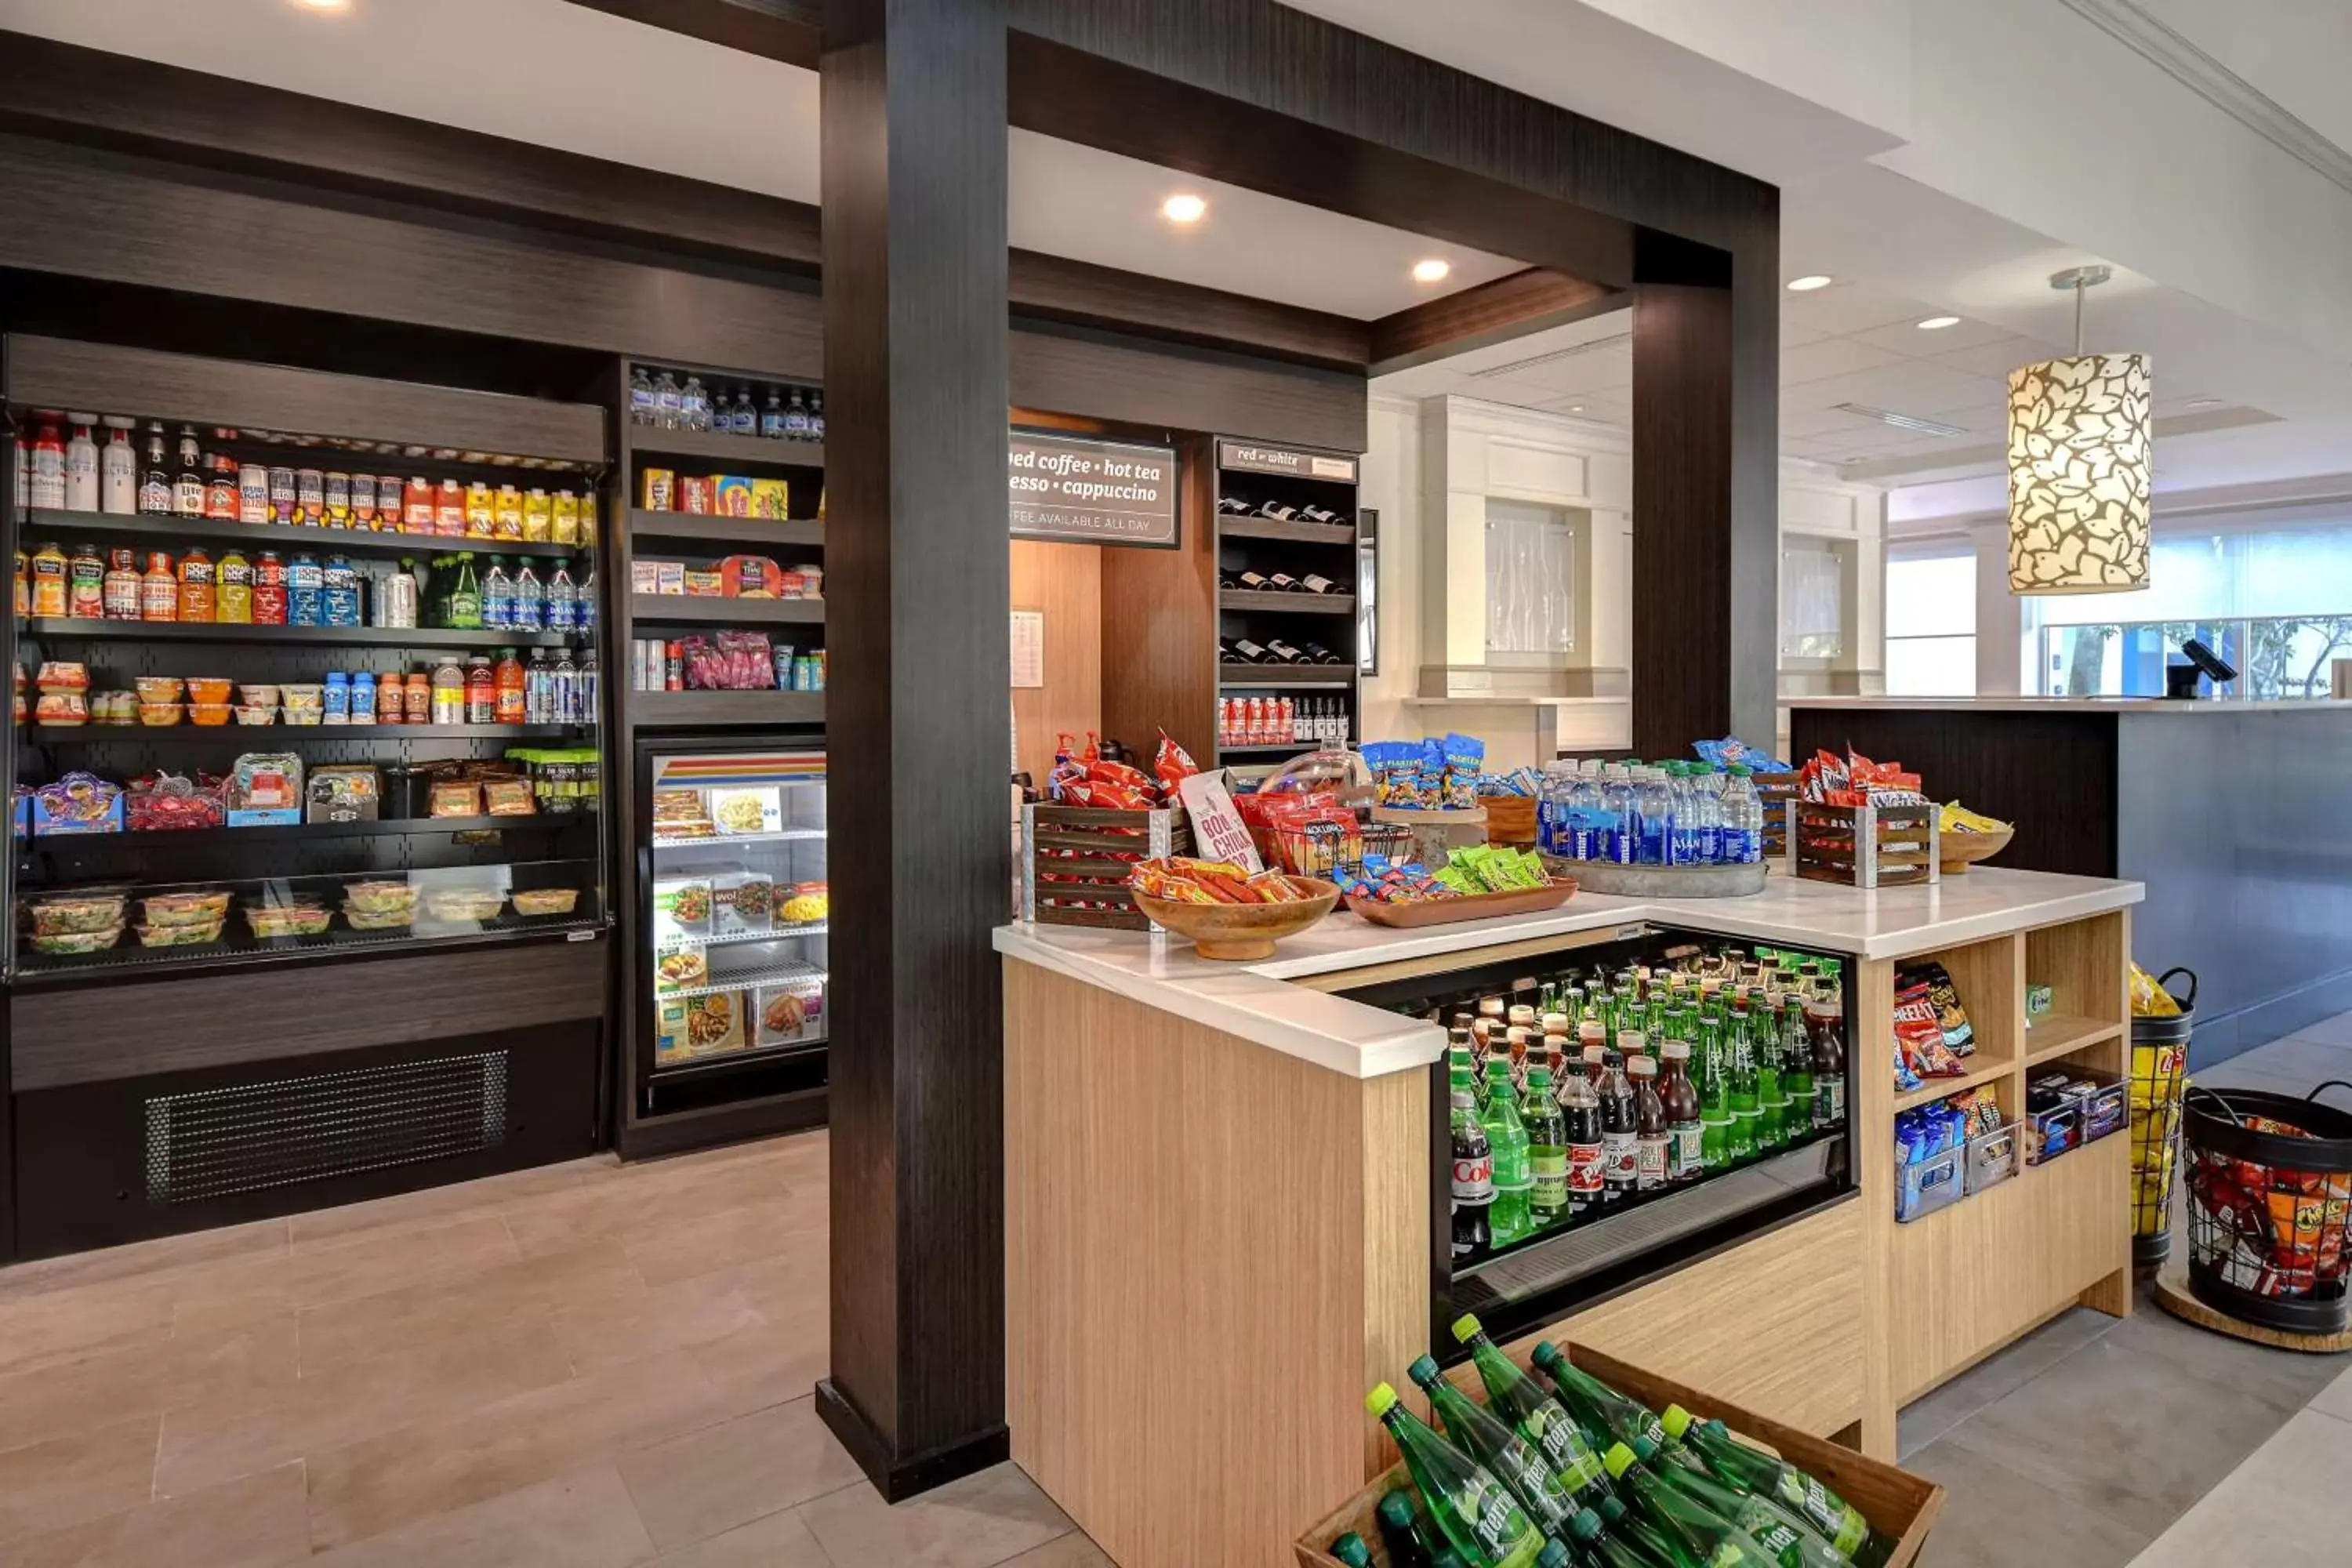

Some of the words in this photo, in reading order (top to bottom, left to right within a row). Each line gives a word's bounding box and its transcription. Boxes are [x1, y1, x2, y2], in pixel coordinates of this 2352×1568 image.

[1038, 455, 1091, 476] coffee
[1104, 459, 1132, 477] hot
[1134, 463, 1160, 481] tea
[1238, 449, 1256, 460] red
[1268, 452, 1299, 466] white
[1062, 480, 1158, 501] cappuccino
[1039, 514, 1102, 528] AVAILABLE
[1104, 517, 1125, 530] ALL
[1128, 520, 1151, 532] DAY
[1621, 835, 1631, 864] smart
